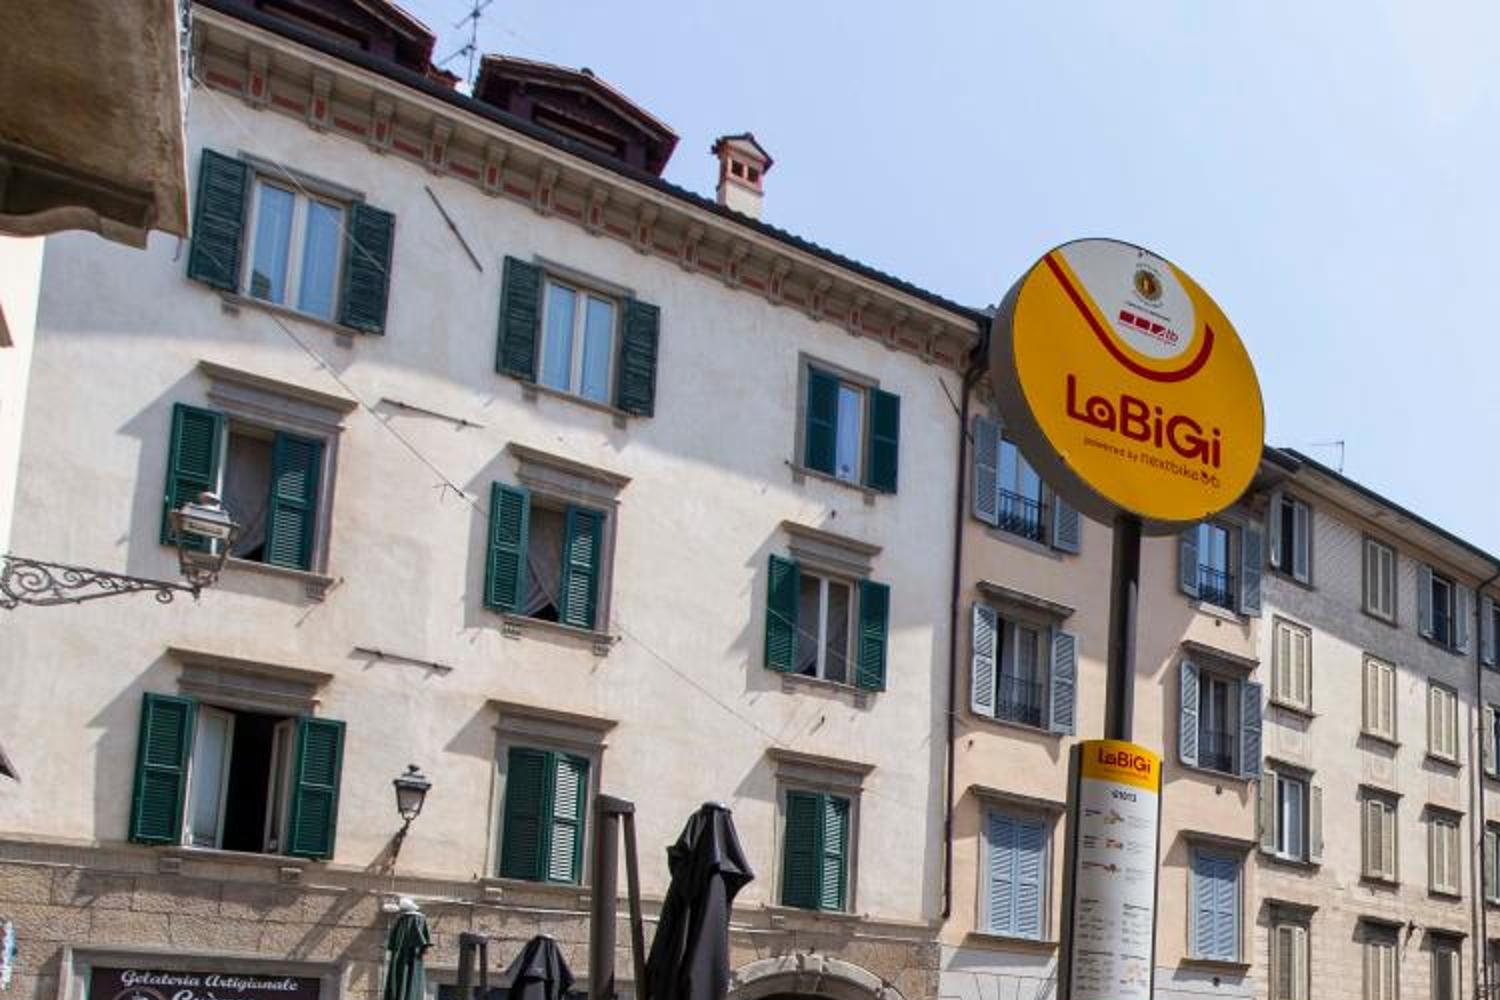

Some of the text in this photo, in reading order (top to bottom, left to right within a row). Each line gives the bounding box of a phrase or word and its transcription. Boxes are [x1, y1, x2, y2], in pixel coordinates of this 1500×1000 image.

[1066, 373, 1221, 469] LaBiGi
[120, 970, 299, 991] Gelateria Artigianale
